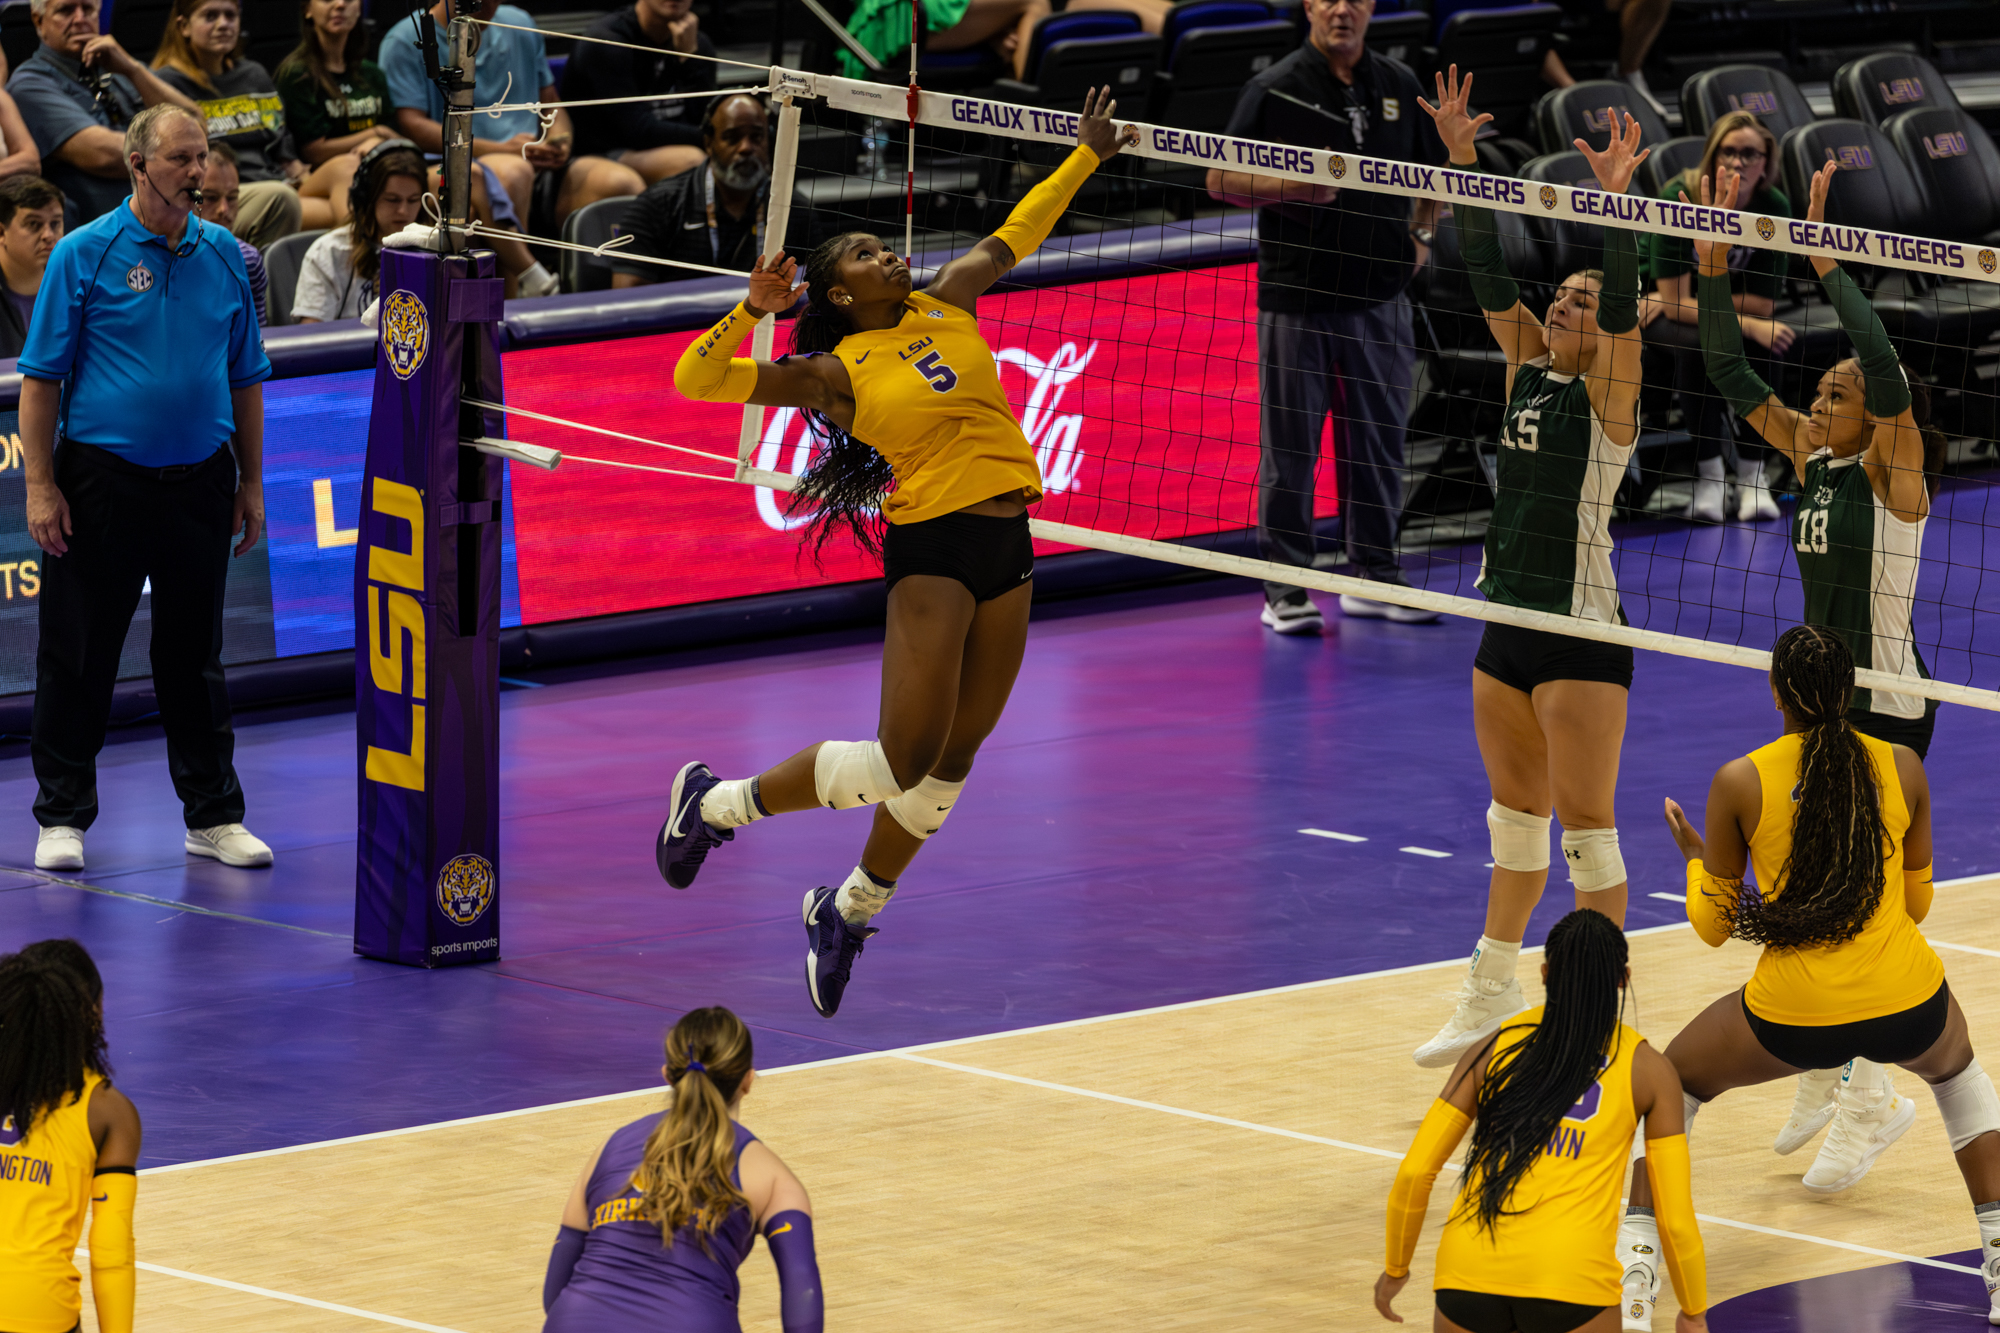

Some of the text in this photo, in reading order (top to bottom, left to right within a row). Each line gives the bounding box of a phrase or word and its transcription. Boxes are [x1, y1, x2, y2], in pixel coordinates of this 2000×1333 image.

[787, 75, 807, 84] Senoh
[851, 89, 882, 99] sports imports
[1879, 77, 1925, 105] LSU
[952, 98, 1079, 138] GEAUX TIGE
[1382, 98, 1400, 121] S
[1728, 91, 1778, 115] LSU
[1152, 128, 1315, 175] GEAUX TIGERS
[1825, 145, 1873, 170] LSU
[1923, 130, 1968, 159] LSU
[1359, 159, 1526, 205] GEAUX TIGERS
[1571, 190, 1743, 237] GEAUX TIGERS
[1788, 221, 1965, 269] GEAUX TIGERS
[129, 267, 151, 291] SEC
[696, 312, 738, 358] GEAUX
[898, 336, 934, 361] LSU
[911, 349, 959, 394] 5
[1500, 408, 1541, 454] 15
[1796, 508, 1829, 555] 18
[365, 476, 426, 792] LSU
[431, 937, 498, 957] sports imports
